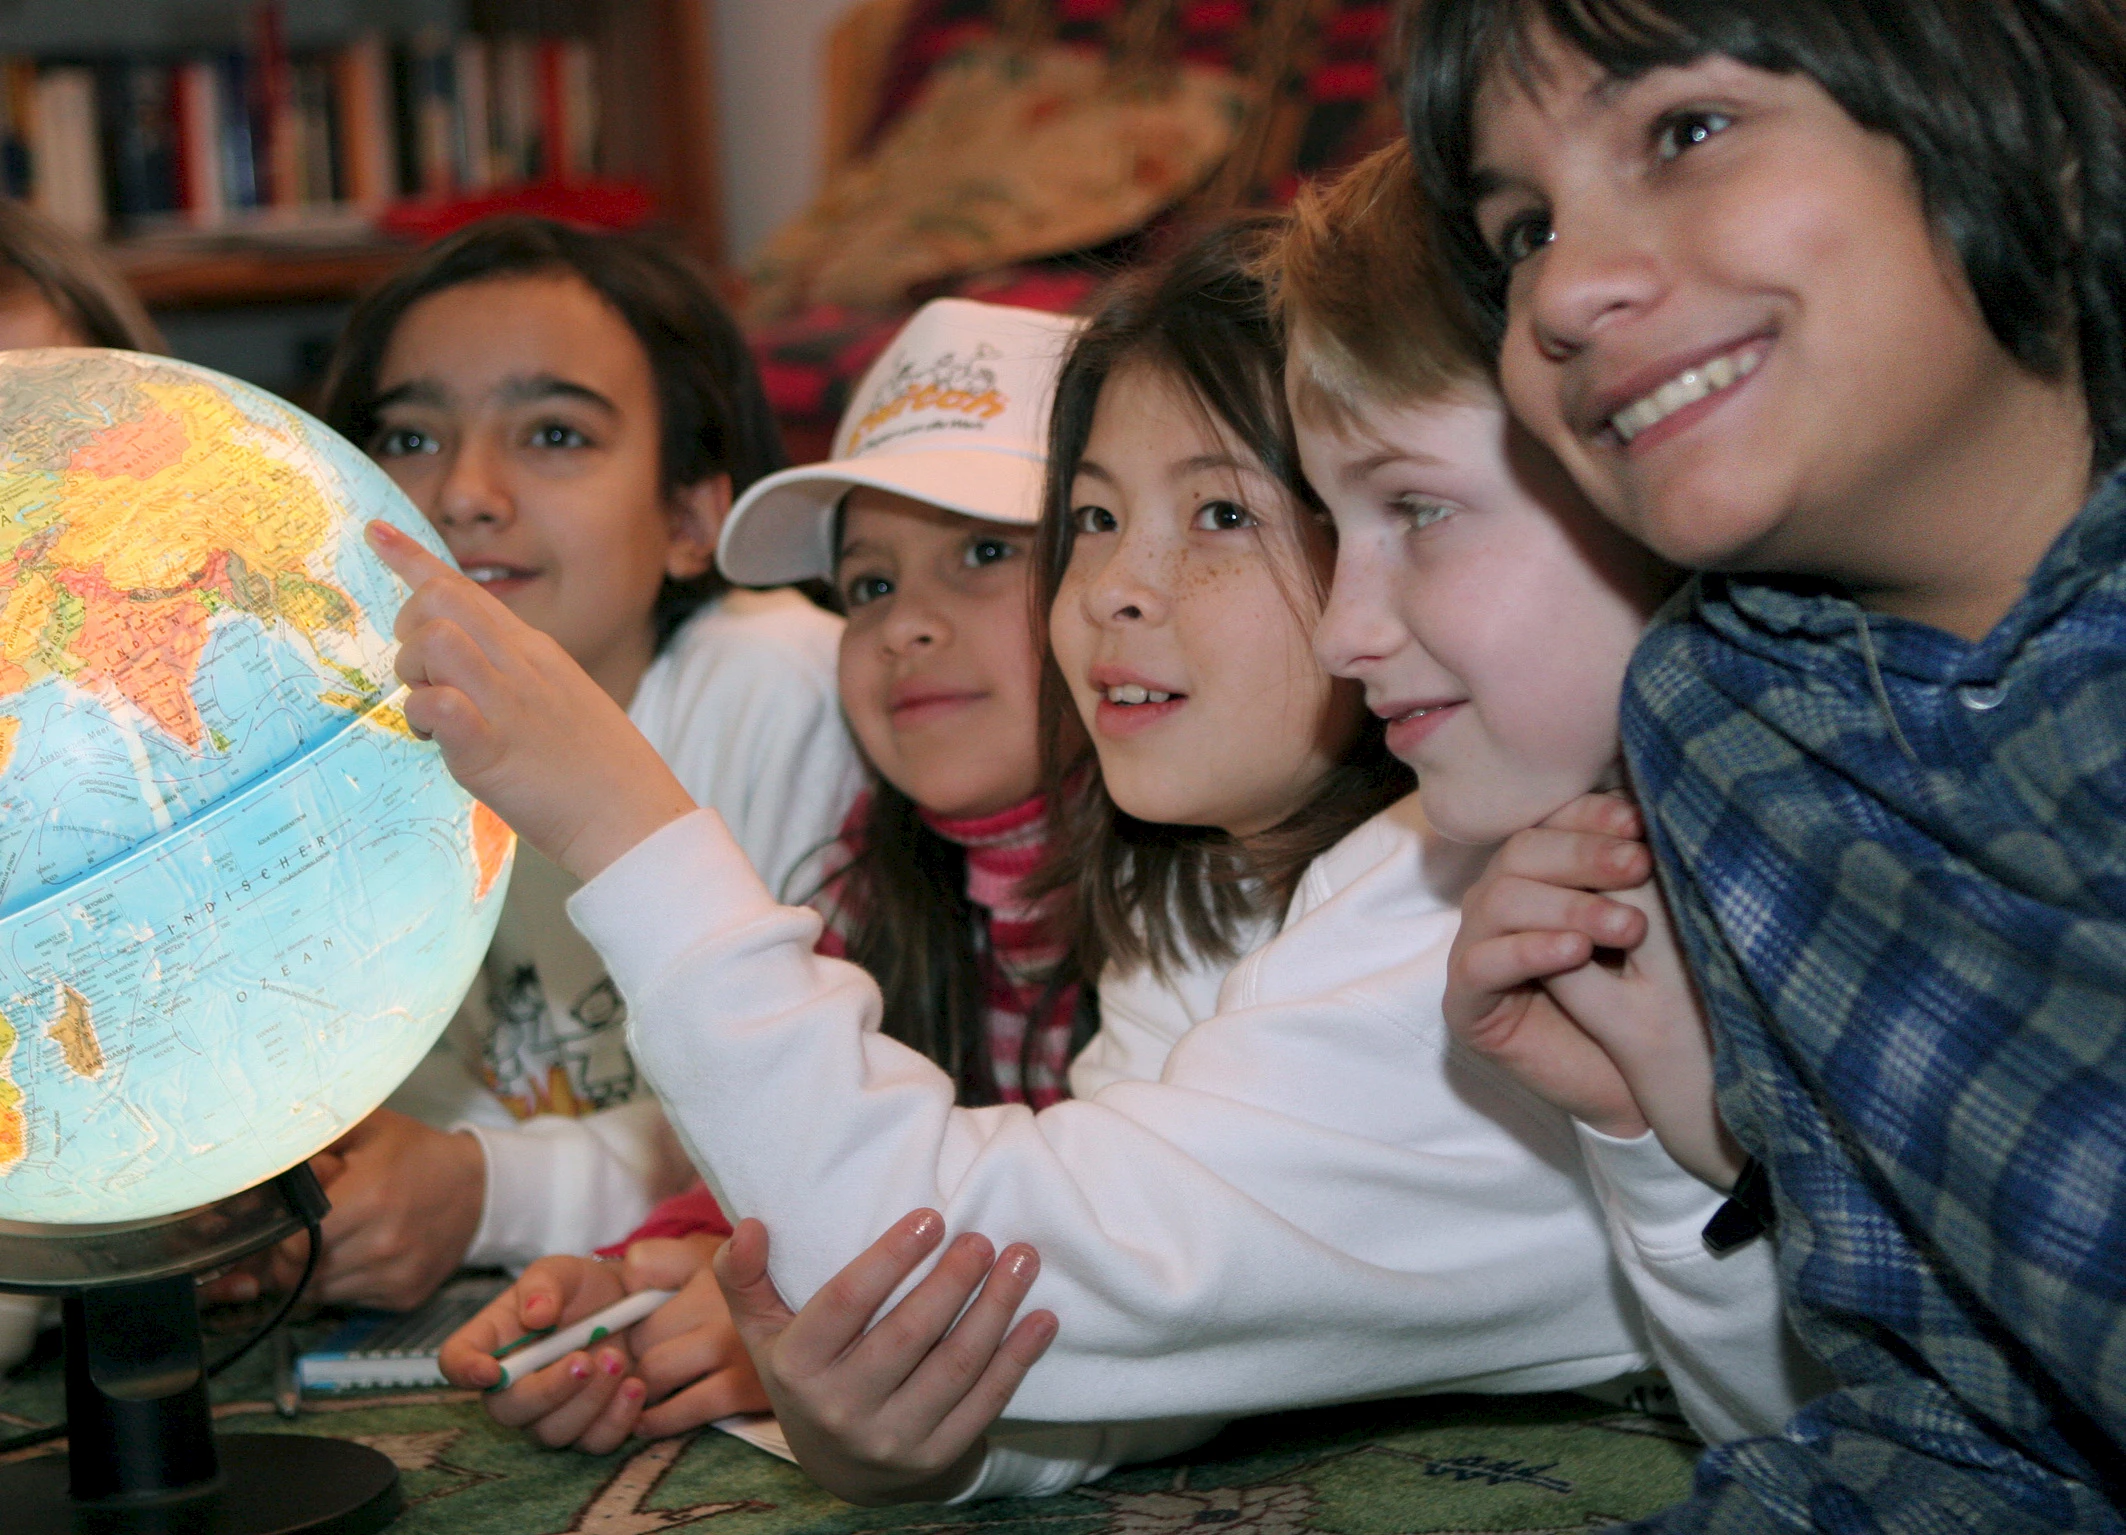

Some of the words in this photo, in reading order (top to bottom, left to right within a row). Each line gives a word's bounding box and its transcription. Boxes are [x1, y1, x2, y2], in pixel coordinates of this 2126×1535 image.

[105, 617, 181, 665] INDIEN
[166, 834, 327, 936] INDISCHER
[235, 936, 334, 1004] OZEAN
[86, 1043, 137, 1071] MADAGASKAR
